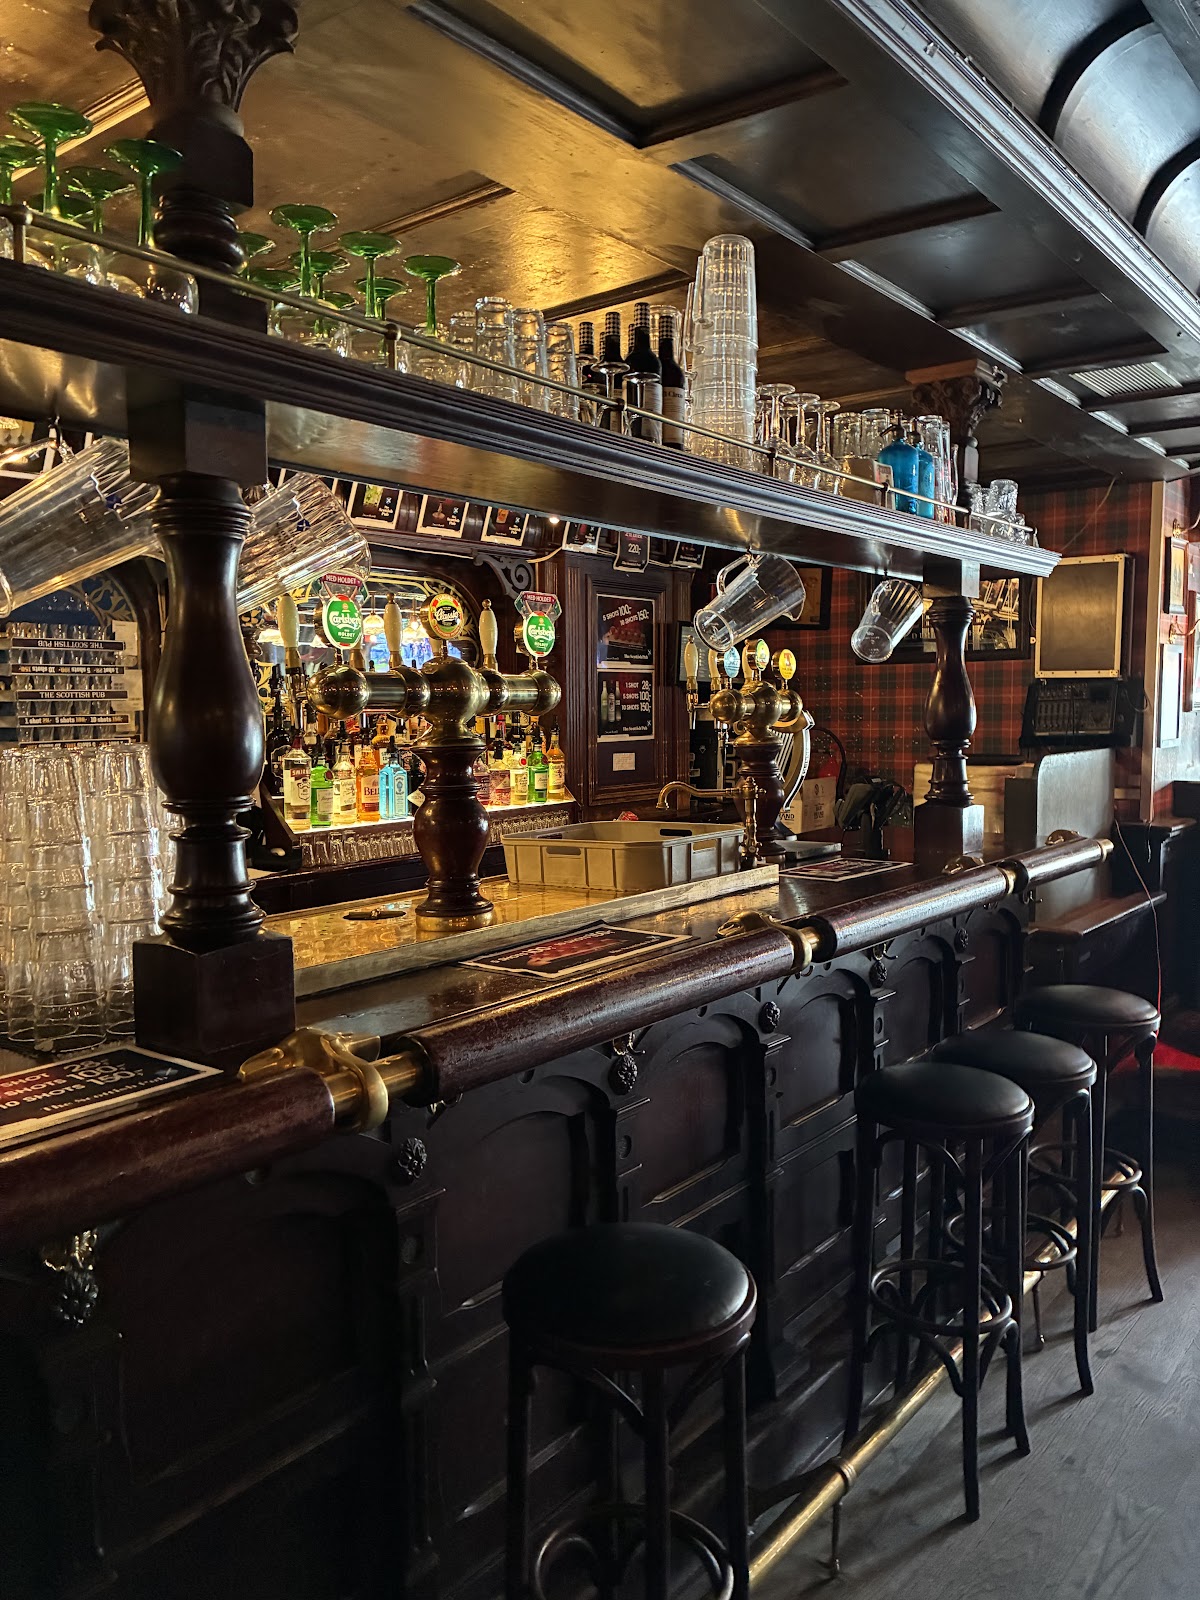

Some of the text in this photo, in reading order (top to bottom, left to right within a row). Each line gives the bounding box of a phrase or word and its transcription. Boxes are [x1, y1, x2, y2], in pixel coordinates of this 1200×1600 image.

[337, 576, 357, 585] HOLDET
[328, 611, 361, 630] Carlsberg
[434, 607, 459, 621] Classic
[606, 610, 619, 620] SHOTS
[624, 614, 638, 624] SHOTS
[528, 625, 555, 641] Carlsberg
[54, 641, 89, 649] SCOTTISH
[39, 691, 55, 699] THE
[55, 691, 91, 699] SCOTTISH
[1, 1072, 50, 1088] SHOT
[9, 1079, 67, 1096] SHOTS
[0, 1098, 20, 1110] 10
[26, 1084, 86, 1103] SHOTS
